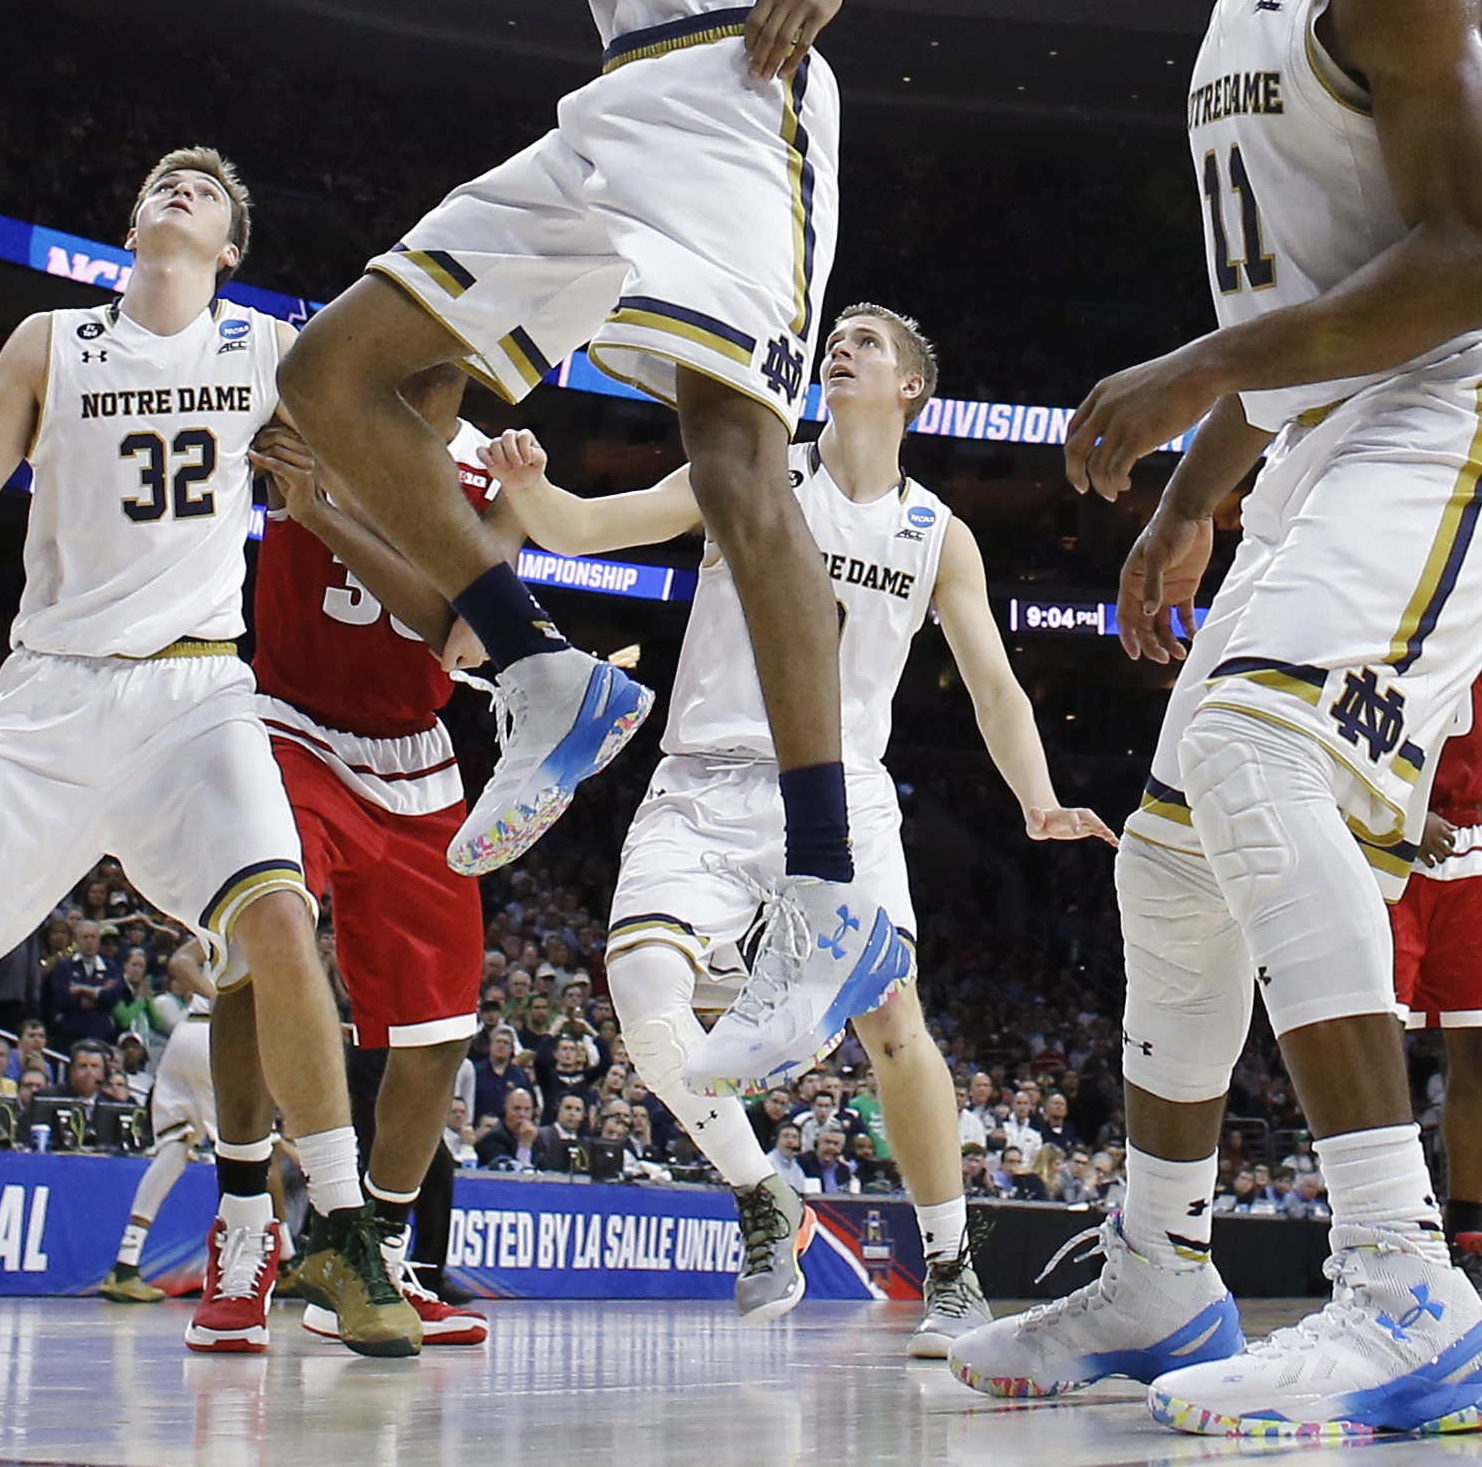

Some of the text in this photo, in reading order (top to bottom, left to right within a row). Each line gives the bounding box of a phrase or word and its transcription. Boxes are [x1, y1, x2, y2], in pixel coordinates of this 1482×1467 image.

[1204, 142, 1277, 296] 11
[216, 340, 249, 355] ACC
[81, 385, 252, 420] NOTRE DAME
[919, 398, 1075, 446] DIVISION
[118, 426, 220, 524] 32
[846, 557, 916, 601] DAME
[1026, 605, 1075, 629] 9:04
[447, 1208, 743, 1272] OSTED BY LA SALLE UNIVE
